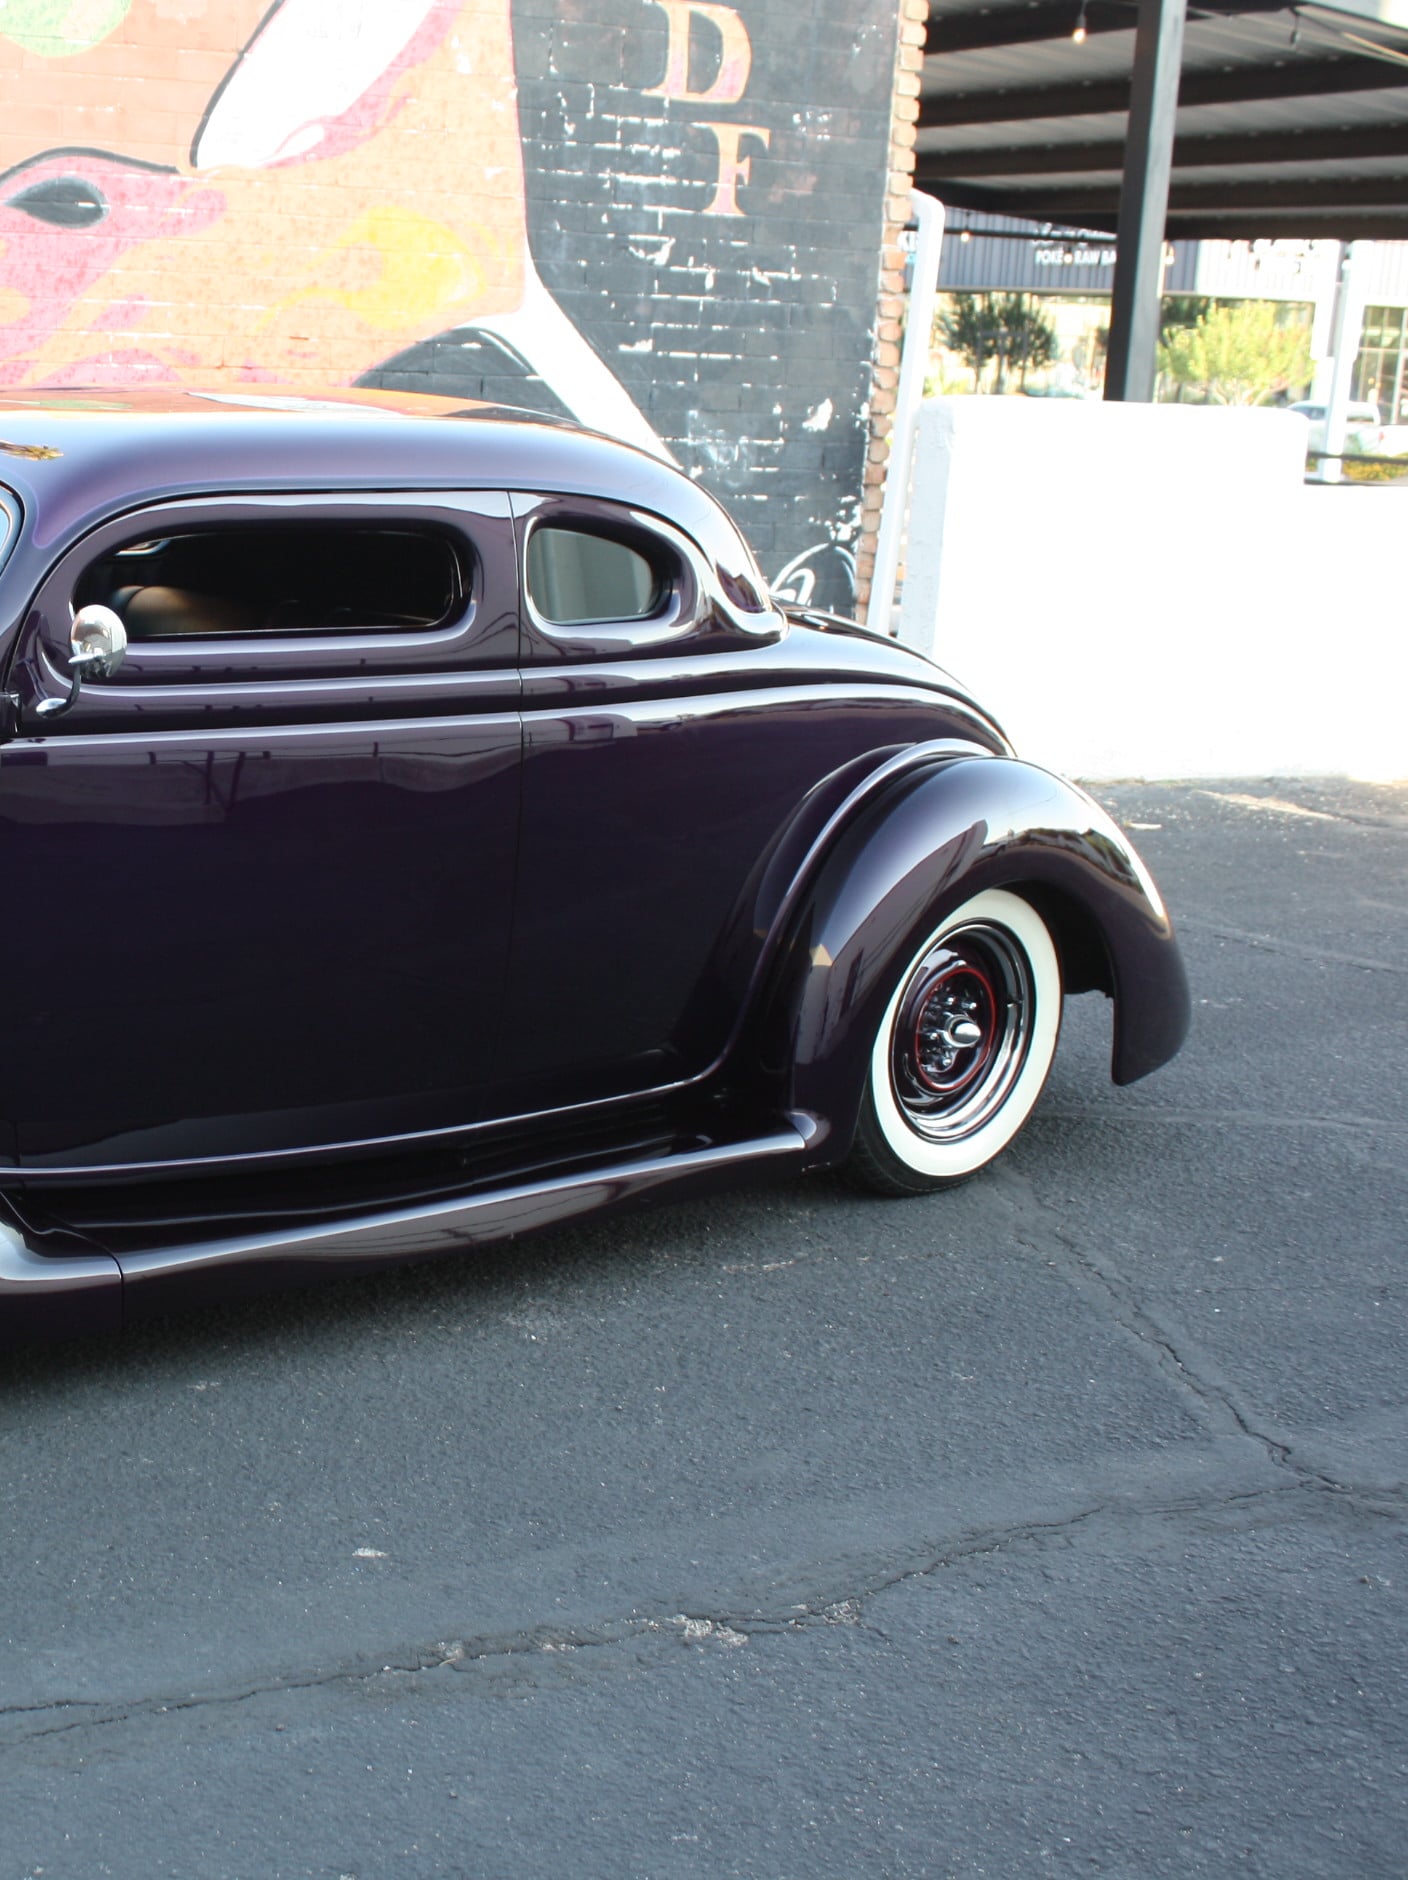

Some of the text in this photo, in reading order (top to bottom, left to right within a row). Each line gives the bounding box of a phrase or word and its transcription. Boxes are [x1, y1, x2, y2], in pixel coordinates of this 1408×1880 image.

[641, 0, 752, 104] D
[700, 122, 770, 216] F
[1100, 249, 1117, 265] BA
